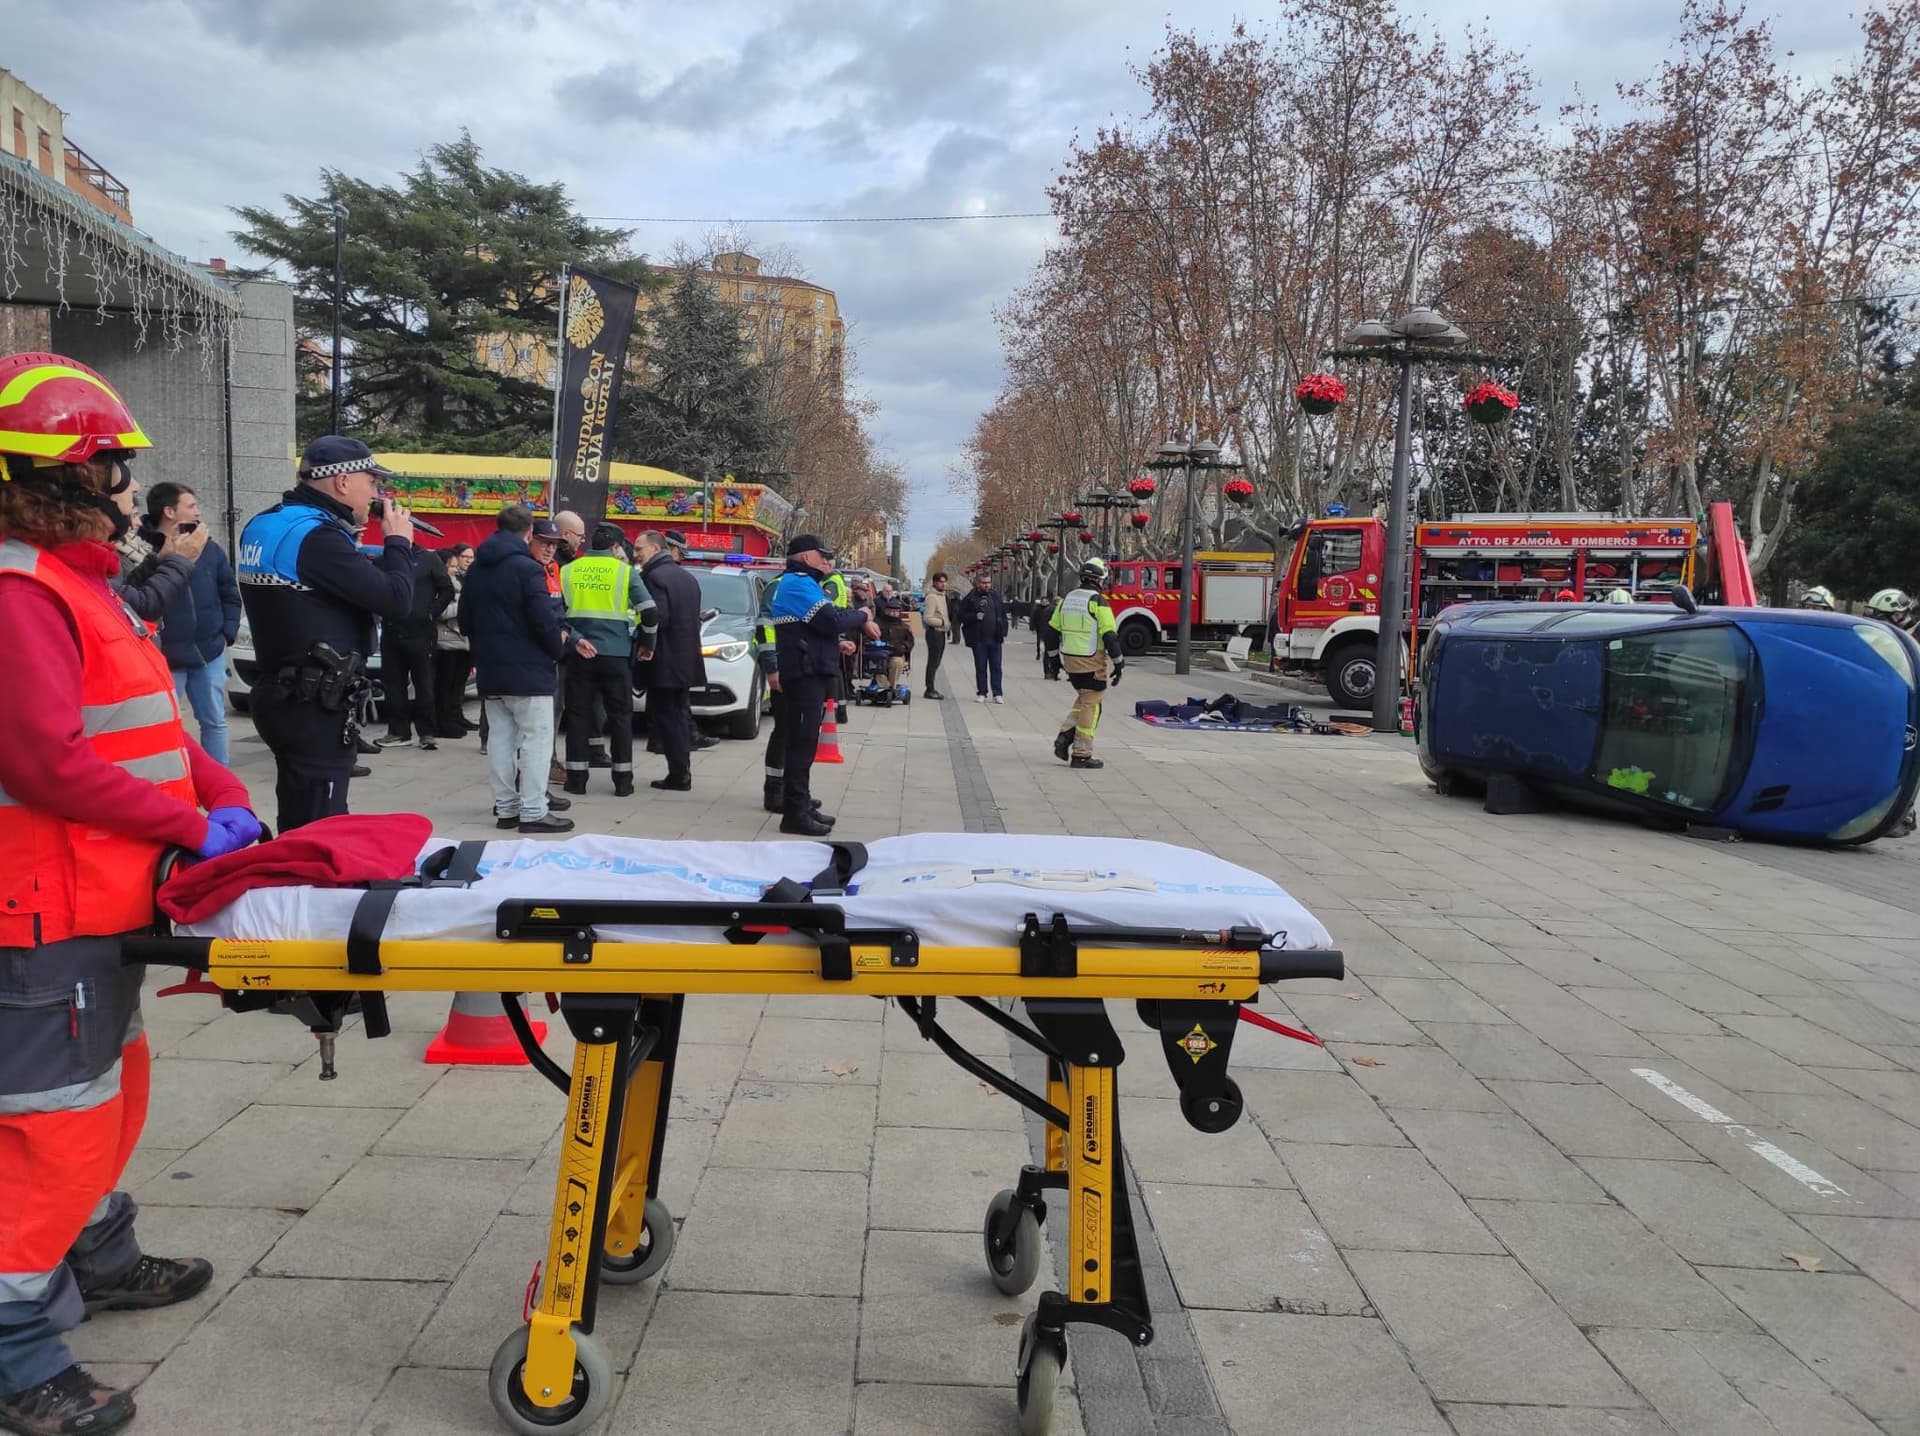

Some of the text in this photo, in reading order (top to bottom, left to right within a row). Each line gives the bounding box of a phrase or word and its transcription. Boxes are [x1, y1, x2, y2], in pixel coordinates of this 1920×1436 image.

[586, 432, 603, 483] CAJA
[1458, 537, 1491, 546] AYTO.
[1494, 537, 1509, 546] DE
[1511, 537, 1561, 546] ZAMORA
[1571, 537, 1638, 546] BOMBEROS
[1665, 536, 1685, 545] 112
[240, 540, 263, 567] LICÍA
[574, 566, 614, 574] GUARDIA
[582, 574, 603, 582] CIVIL
[580, 1075, 593, 1120] PROMEBA
